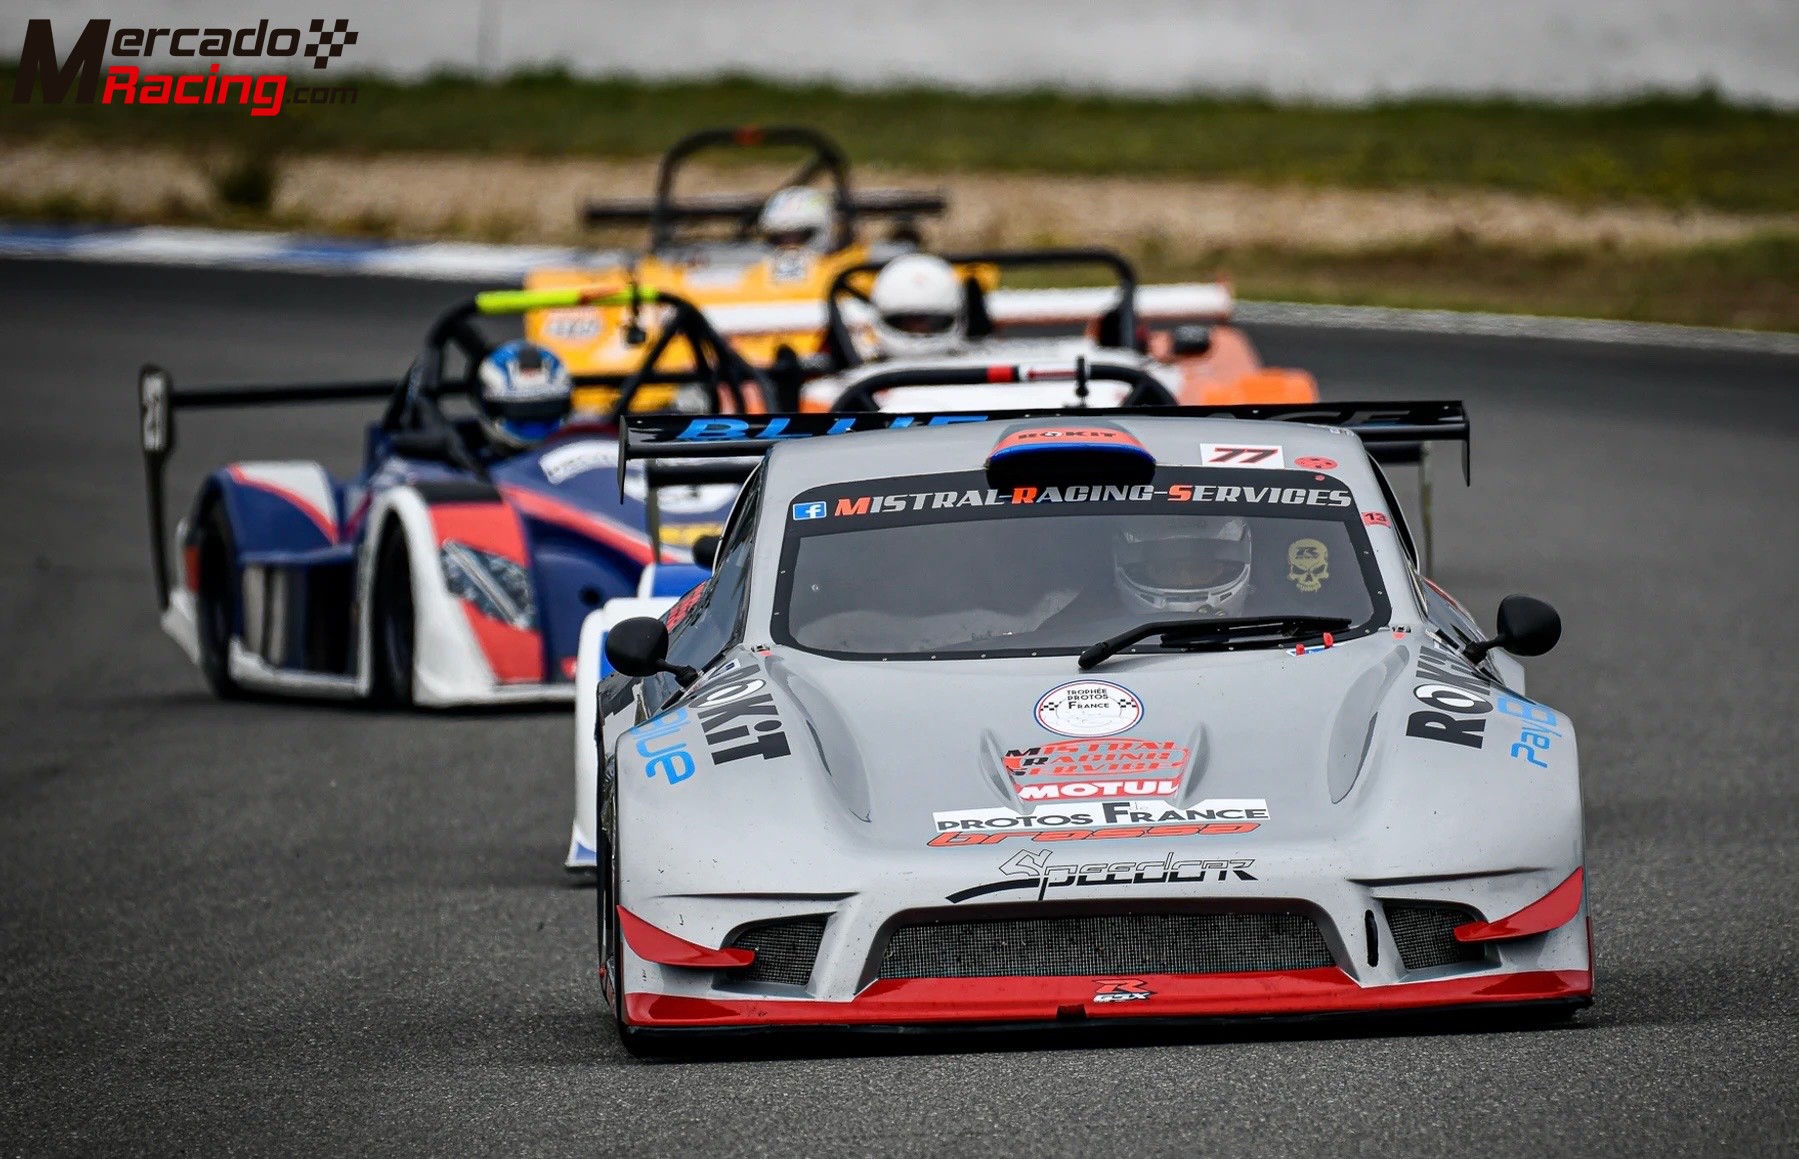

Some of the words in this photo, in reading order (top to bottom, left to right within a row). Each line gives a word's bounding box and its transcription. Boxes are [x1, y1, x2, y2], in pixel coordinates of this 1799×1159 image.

[1208, 447, 1279, 463] 77
[1365, 512, 1387, 522] 13
[1068, 701, 1110, 709] FRANCE
[1018, 780, 1180, 799] MOTUL
[937, 813, 1093, 831] PROTOS
[1102, 801, 1268, 823] FRANCE
